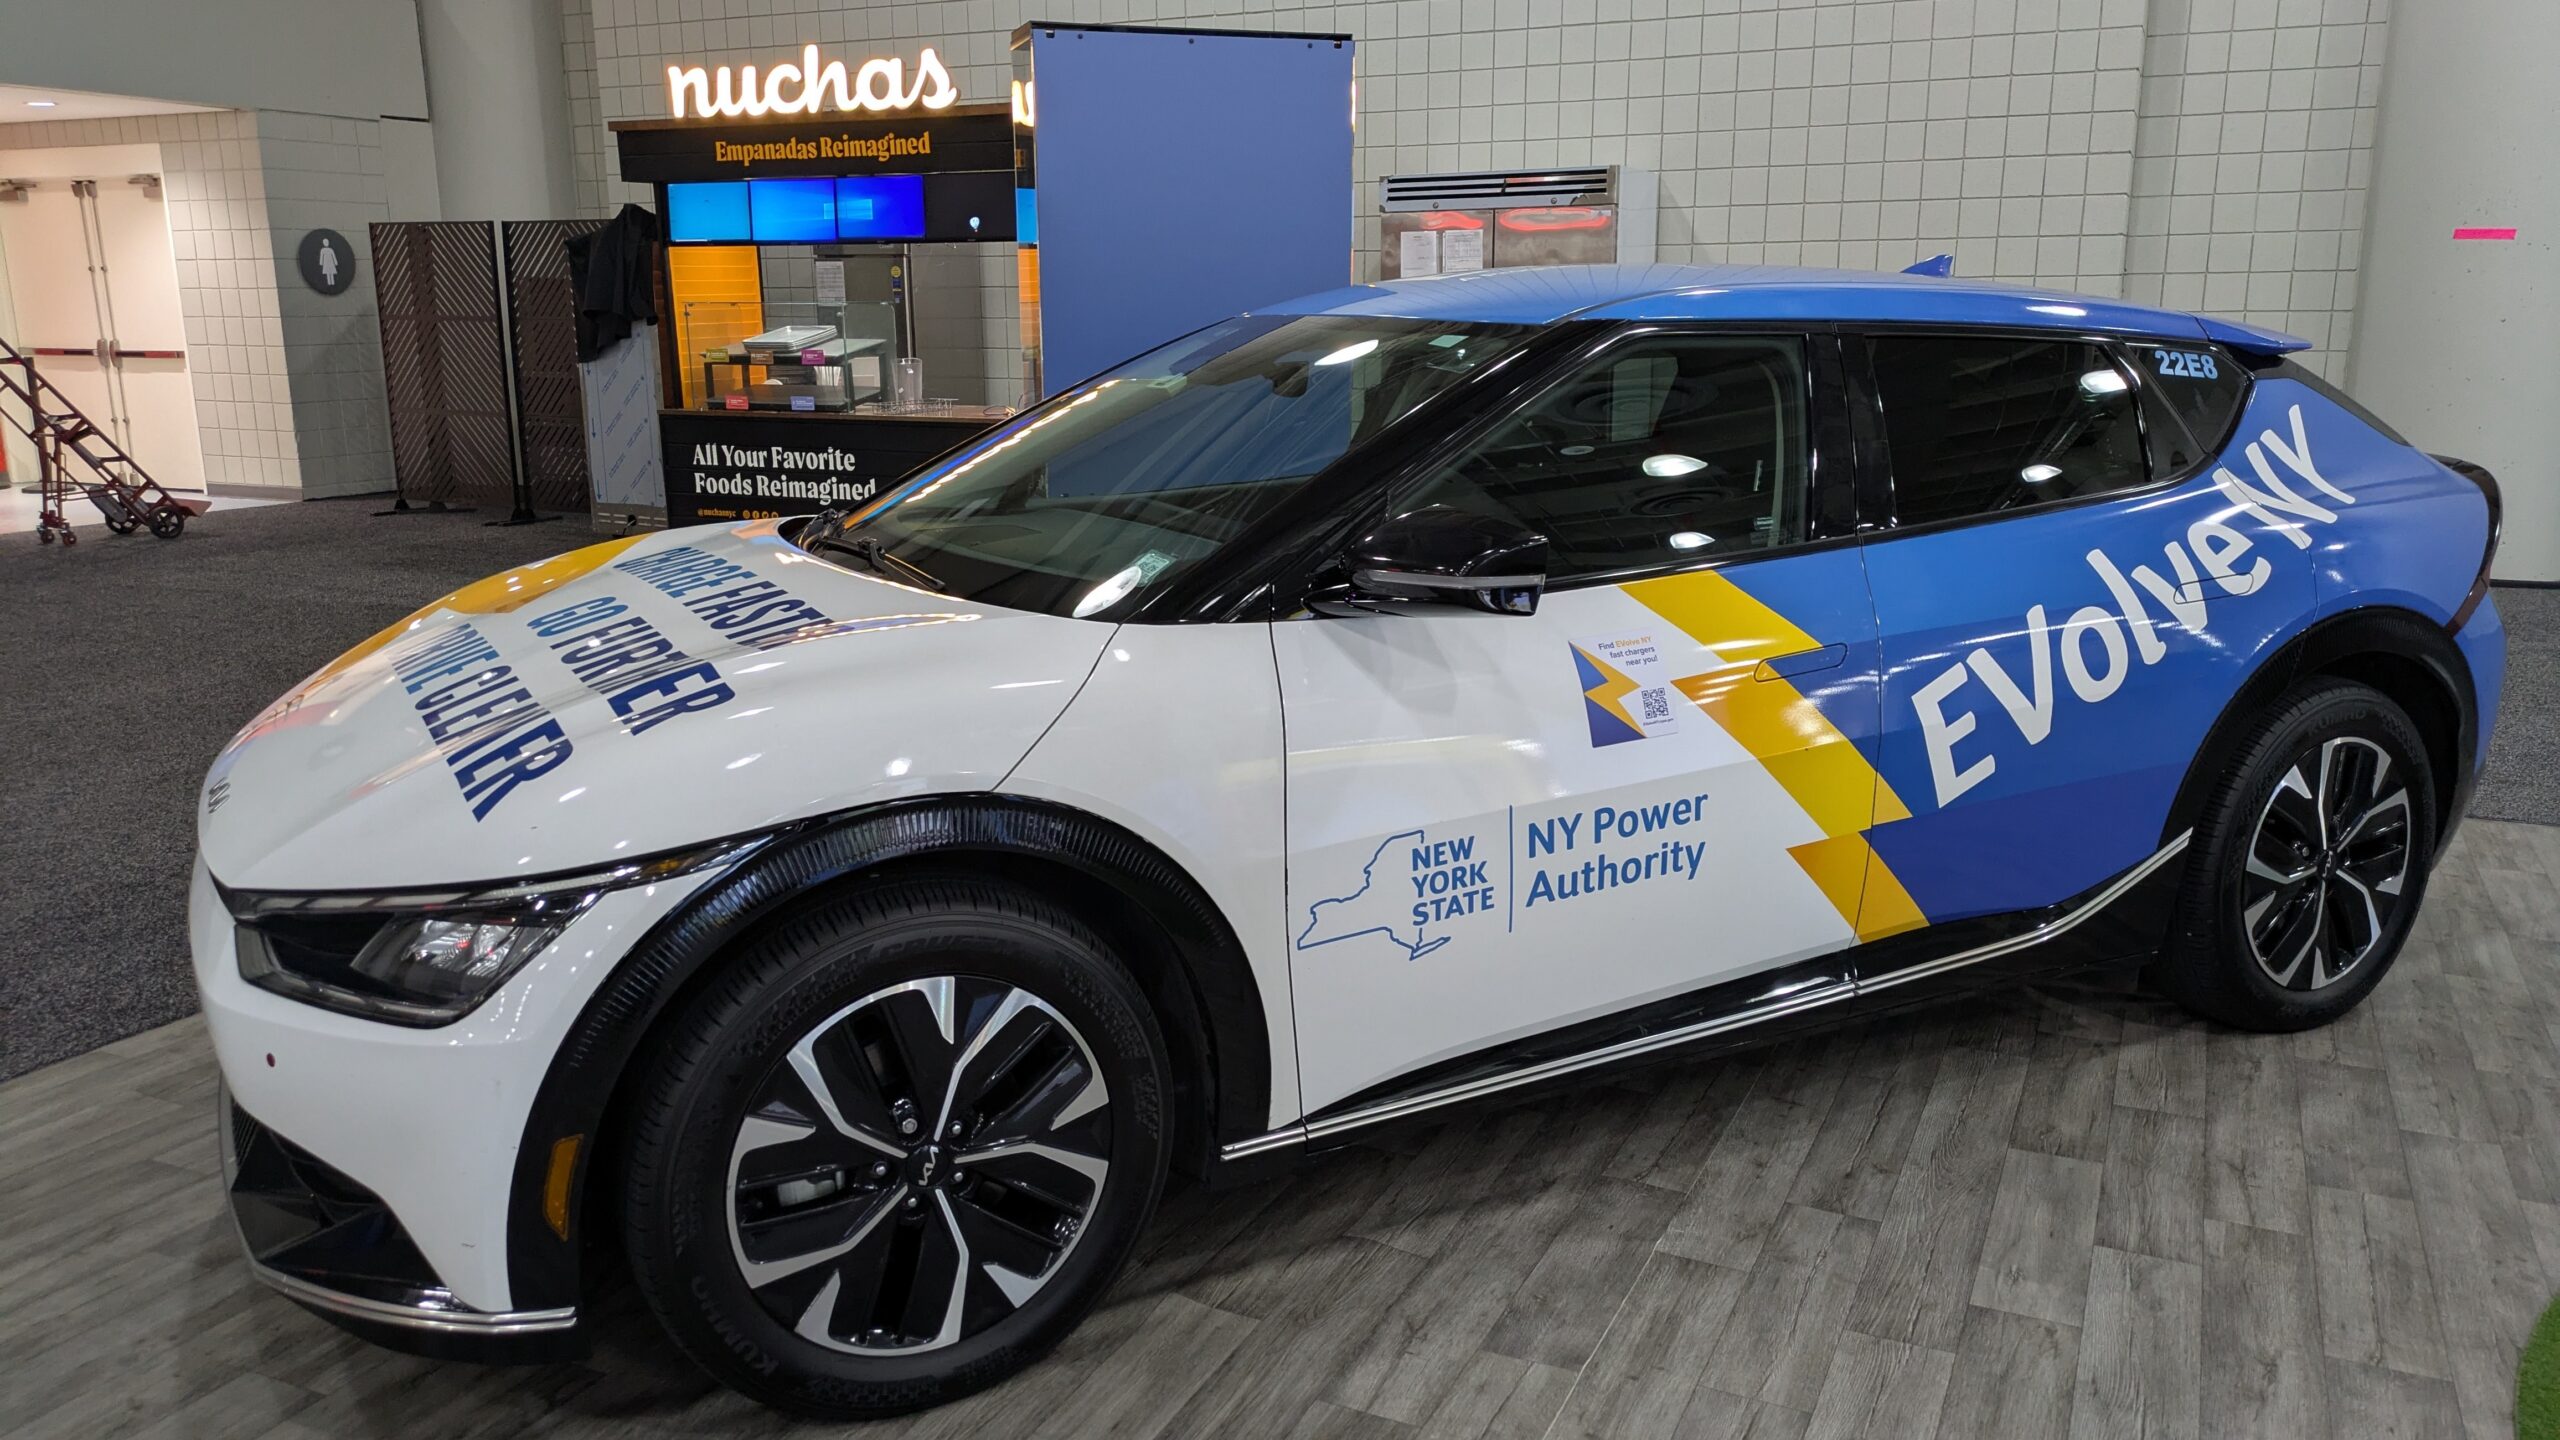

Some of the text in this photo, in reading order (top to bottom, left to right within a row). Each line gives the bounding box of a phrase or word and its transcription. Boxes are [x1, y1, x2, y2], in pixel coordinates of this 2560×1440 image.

[667, 44, 958, 118] nuchas
[715, 131, 931, 166] Empanadas Reimagined
[2154, 349, 2219, 380] 22E8
[693, 443, 856, 472] All Your Favorite
[694, 472, 877, 506] Foods Reimagined
[613, 546, 758, 599] CHARGE
[527, 596, 629, 637] GO
[390, 622, 500, 695] DRIVE
[1598, 642, 1615, 651] Find
[1639, 635, 1652, 645] NY
[1609, 645, 1655, 658] fast chargers
[1625, 654, 1658, 667] near you!
[1528, 793, 1709, 858] NY Power
[1411, 835, 1476, 871] NEW
[1411, 861, 1489, 899] YORK
[1526, 840, 1706, 907] Authority
[1411, 887, 1495, 926] STATE
